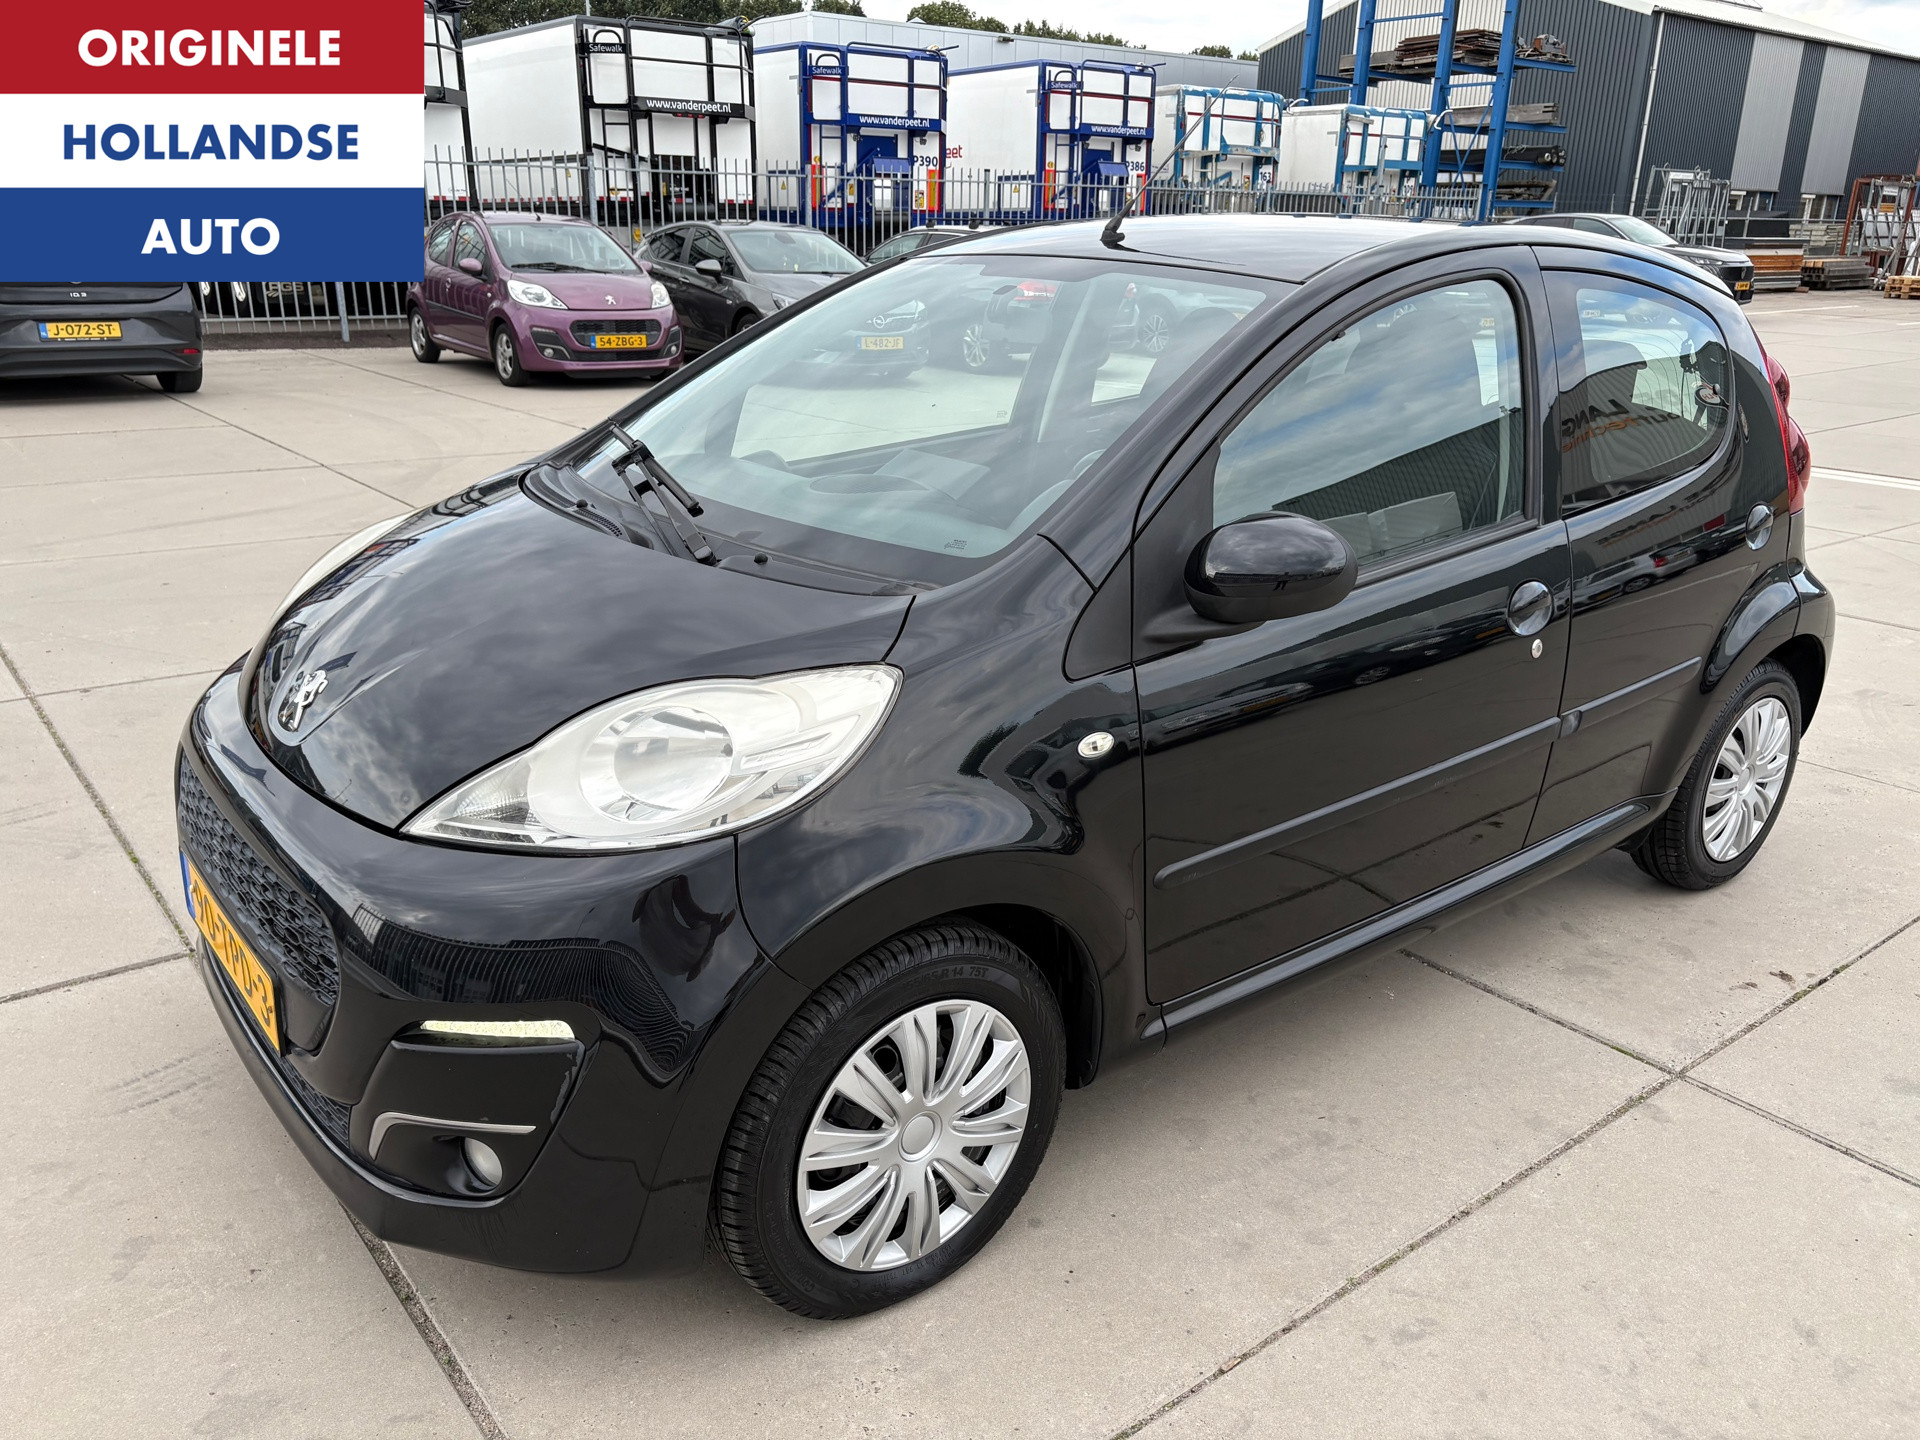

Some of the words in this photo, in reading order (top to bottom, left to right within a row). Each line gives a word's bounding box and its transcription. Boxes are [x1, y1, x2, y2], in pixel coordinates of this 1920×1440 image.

[589, 44, 622, 52] Safewalk
[646, 100, 732, 113] www.vanderpeet.nl
[859, 116, 930, 128] www.vanderpeet.nl
[1091, 125, 1146, 136] www.vanderpeet.nl
[946, 145, 962, 158] eet
[913, 156, 938, 167] P390
[54, 324, 113, 336] J-072-ST
[600, 337, 643, 346] 54-ZBG-3
[865, 338, 902, 348] L-482-JF
[193, 879, 271, 1028] 90-TPD-3
